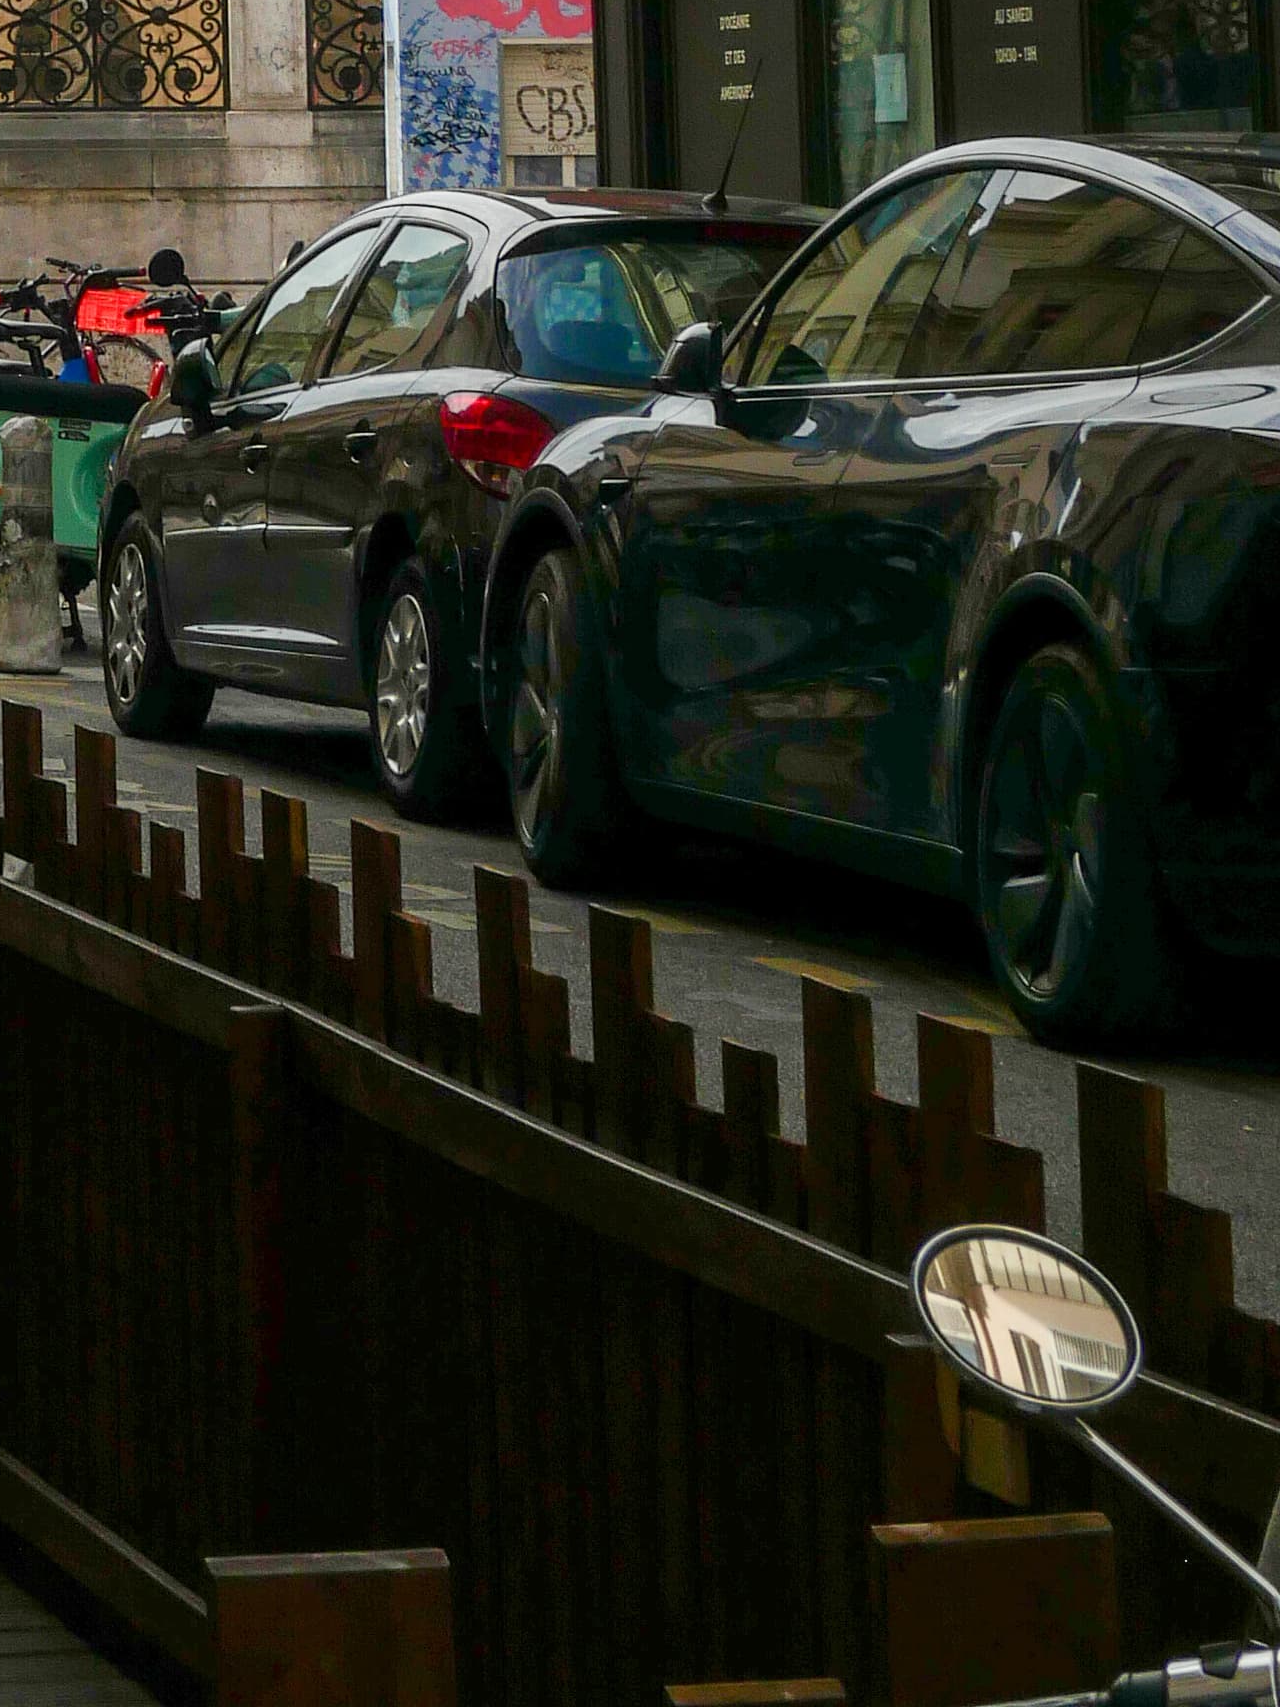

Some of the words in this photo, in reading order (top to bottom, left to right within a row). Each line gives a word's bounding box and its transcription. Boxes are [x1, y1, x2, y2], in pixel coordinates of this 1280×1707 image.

[994, 9, 1005, 25] AU
[1006, 6, 1033, 24] SAMEDI
[733, 49, 746, 65] DES
